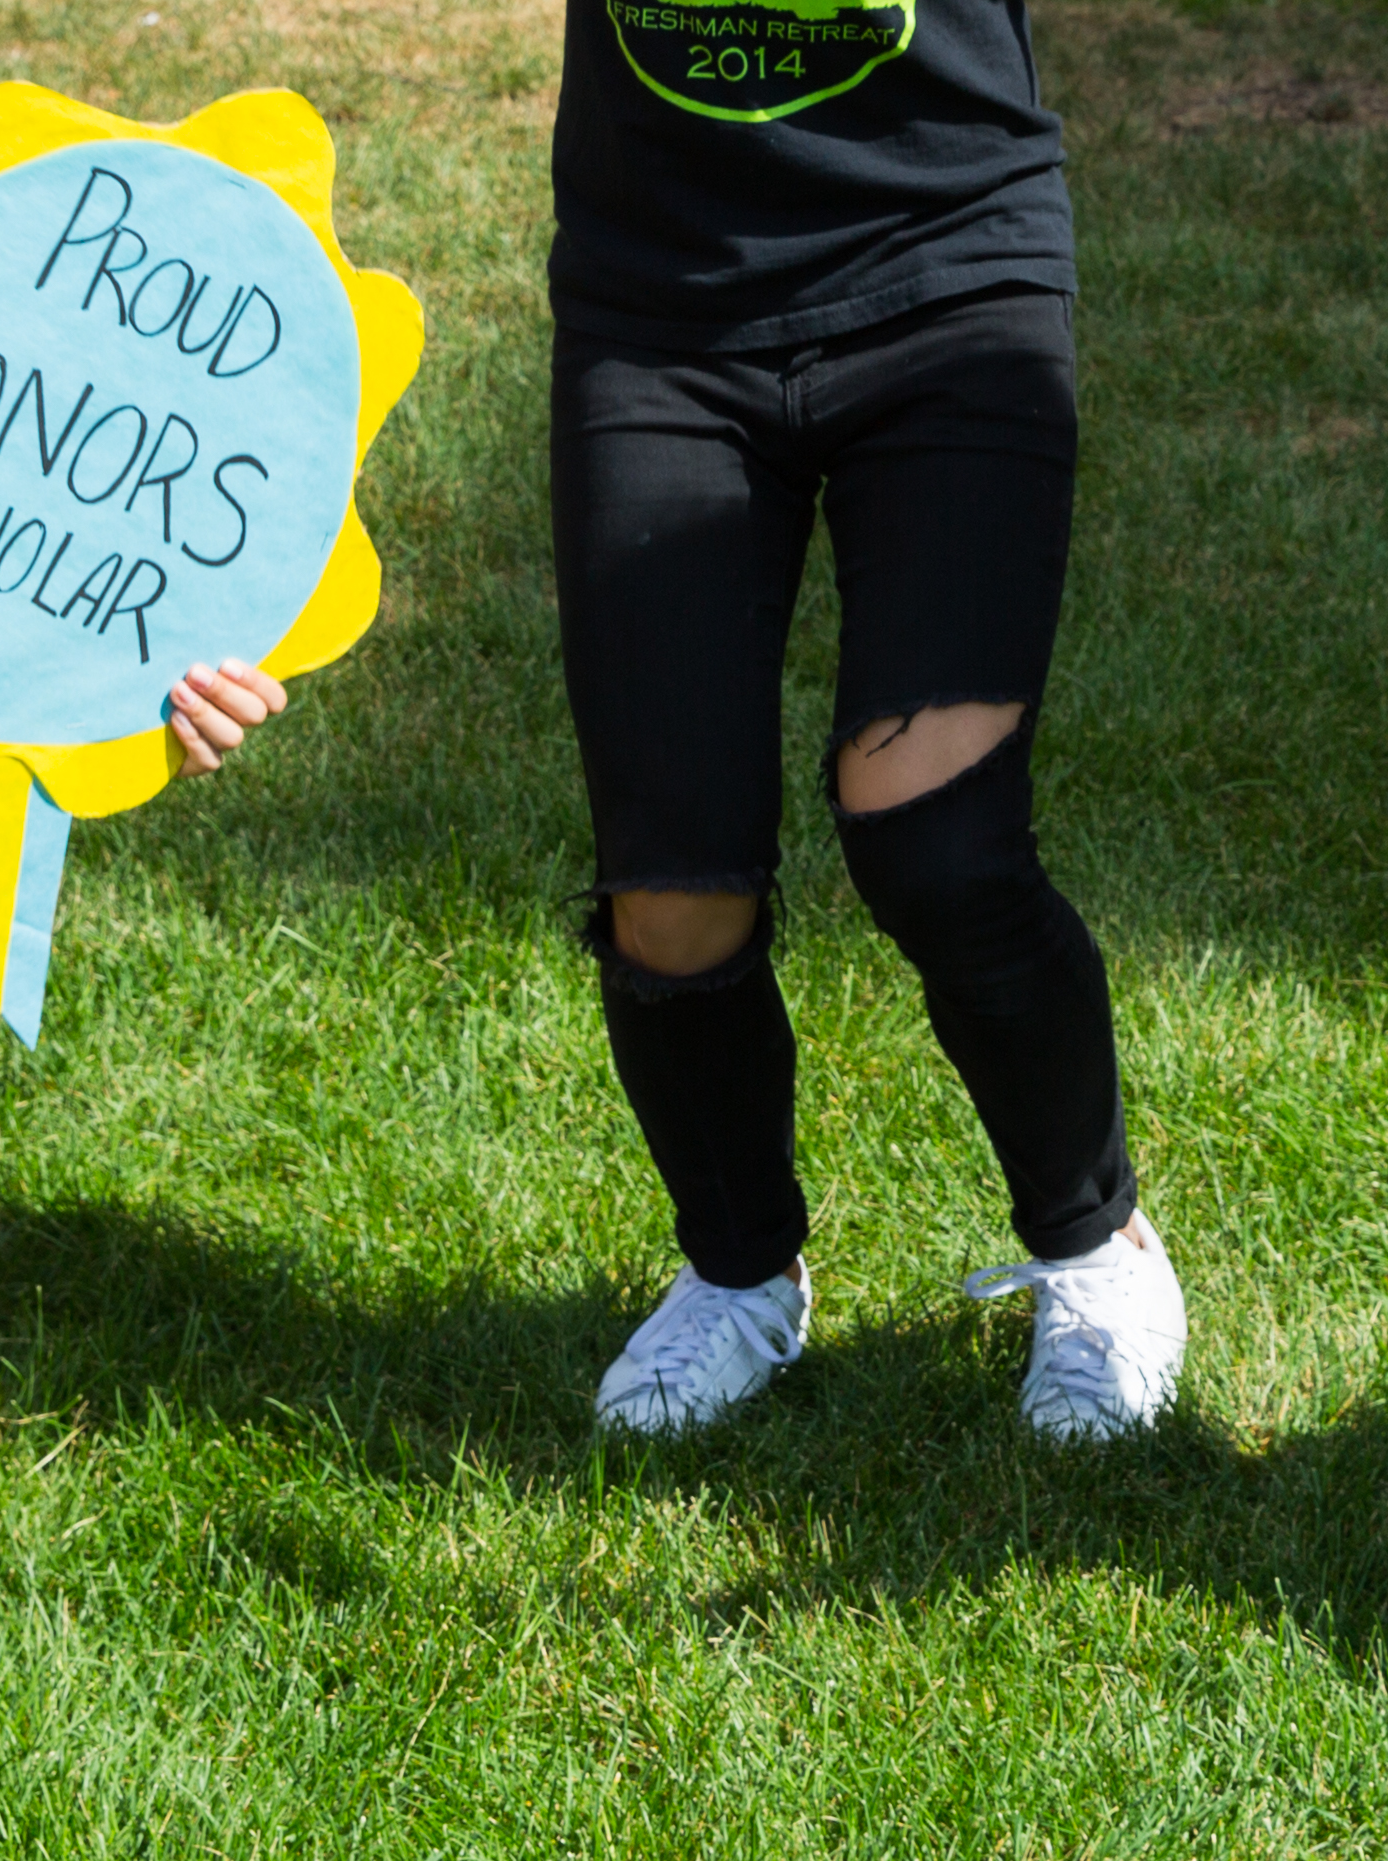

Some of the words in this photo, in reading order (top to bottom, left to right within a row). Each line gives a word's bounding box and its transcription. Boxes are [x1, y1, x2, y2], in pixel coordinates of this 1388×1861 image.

[613, 0, 757, 38] FRESHMAN
[767, 20, 895, 45] RETREAT
[686, 44, 806, 81] 2014
[35, 167, 280, 377] PROUD
